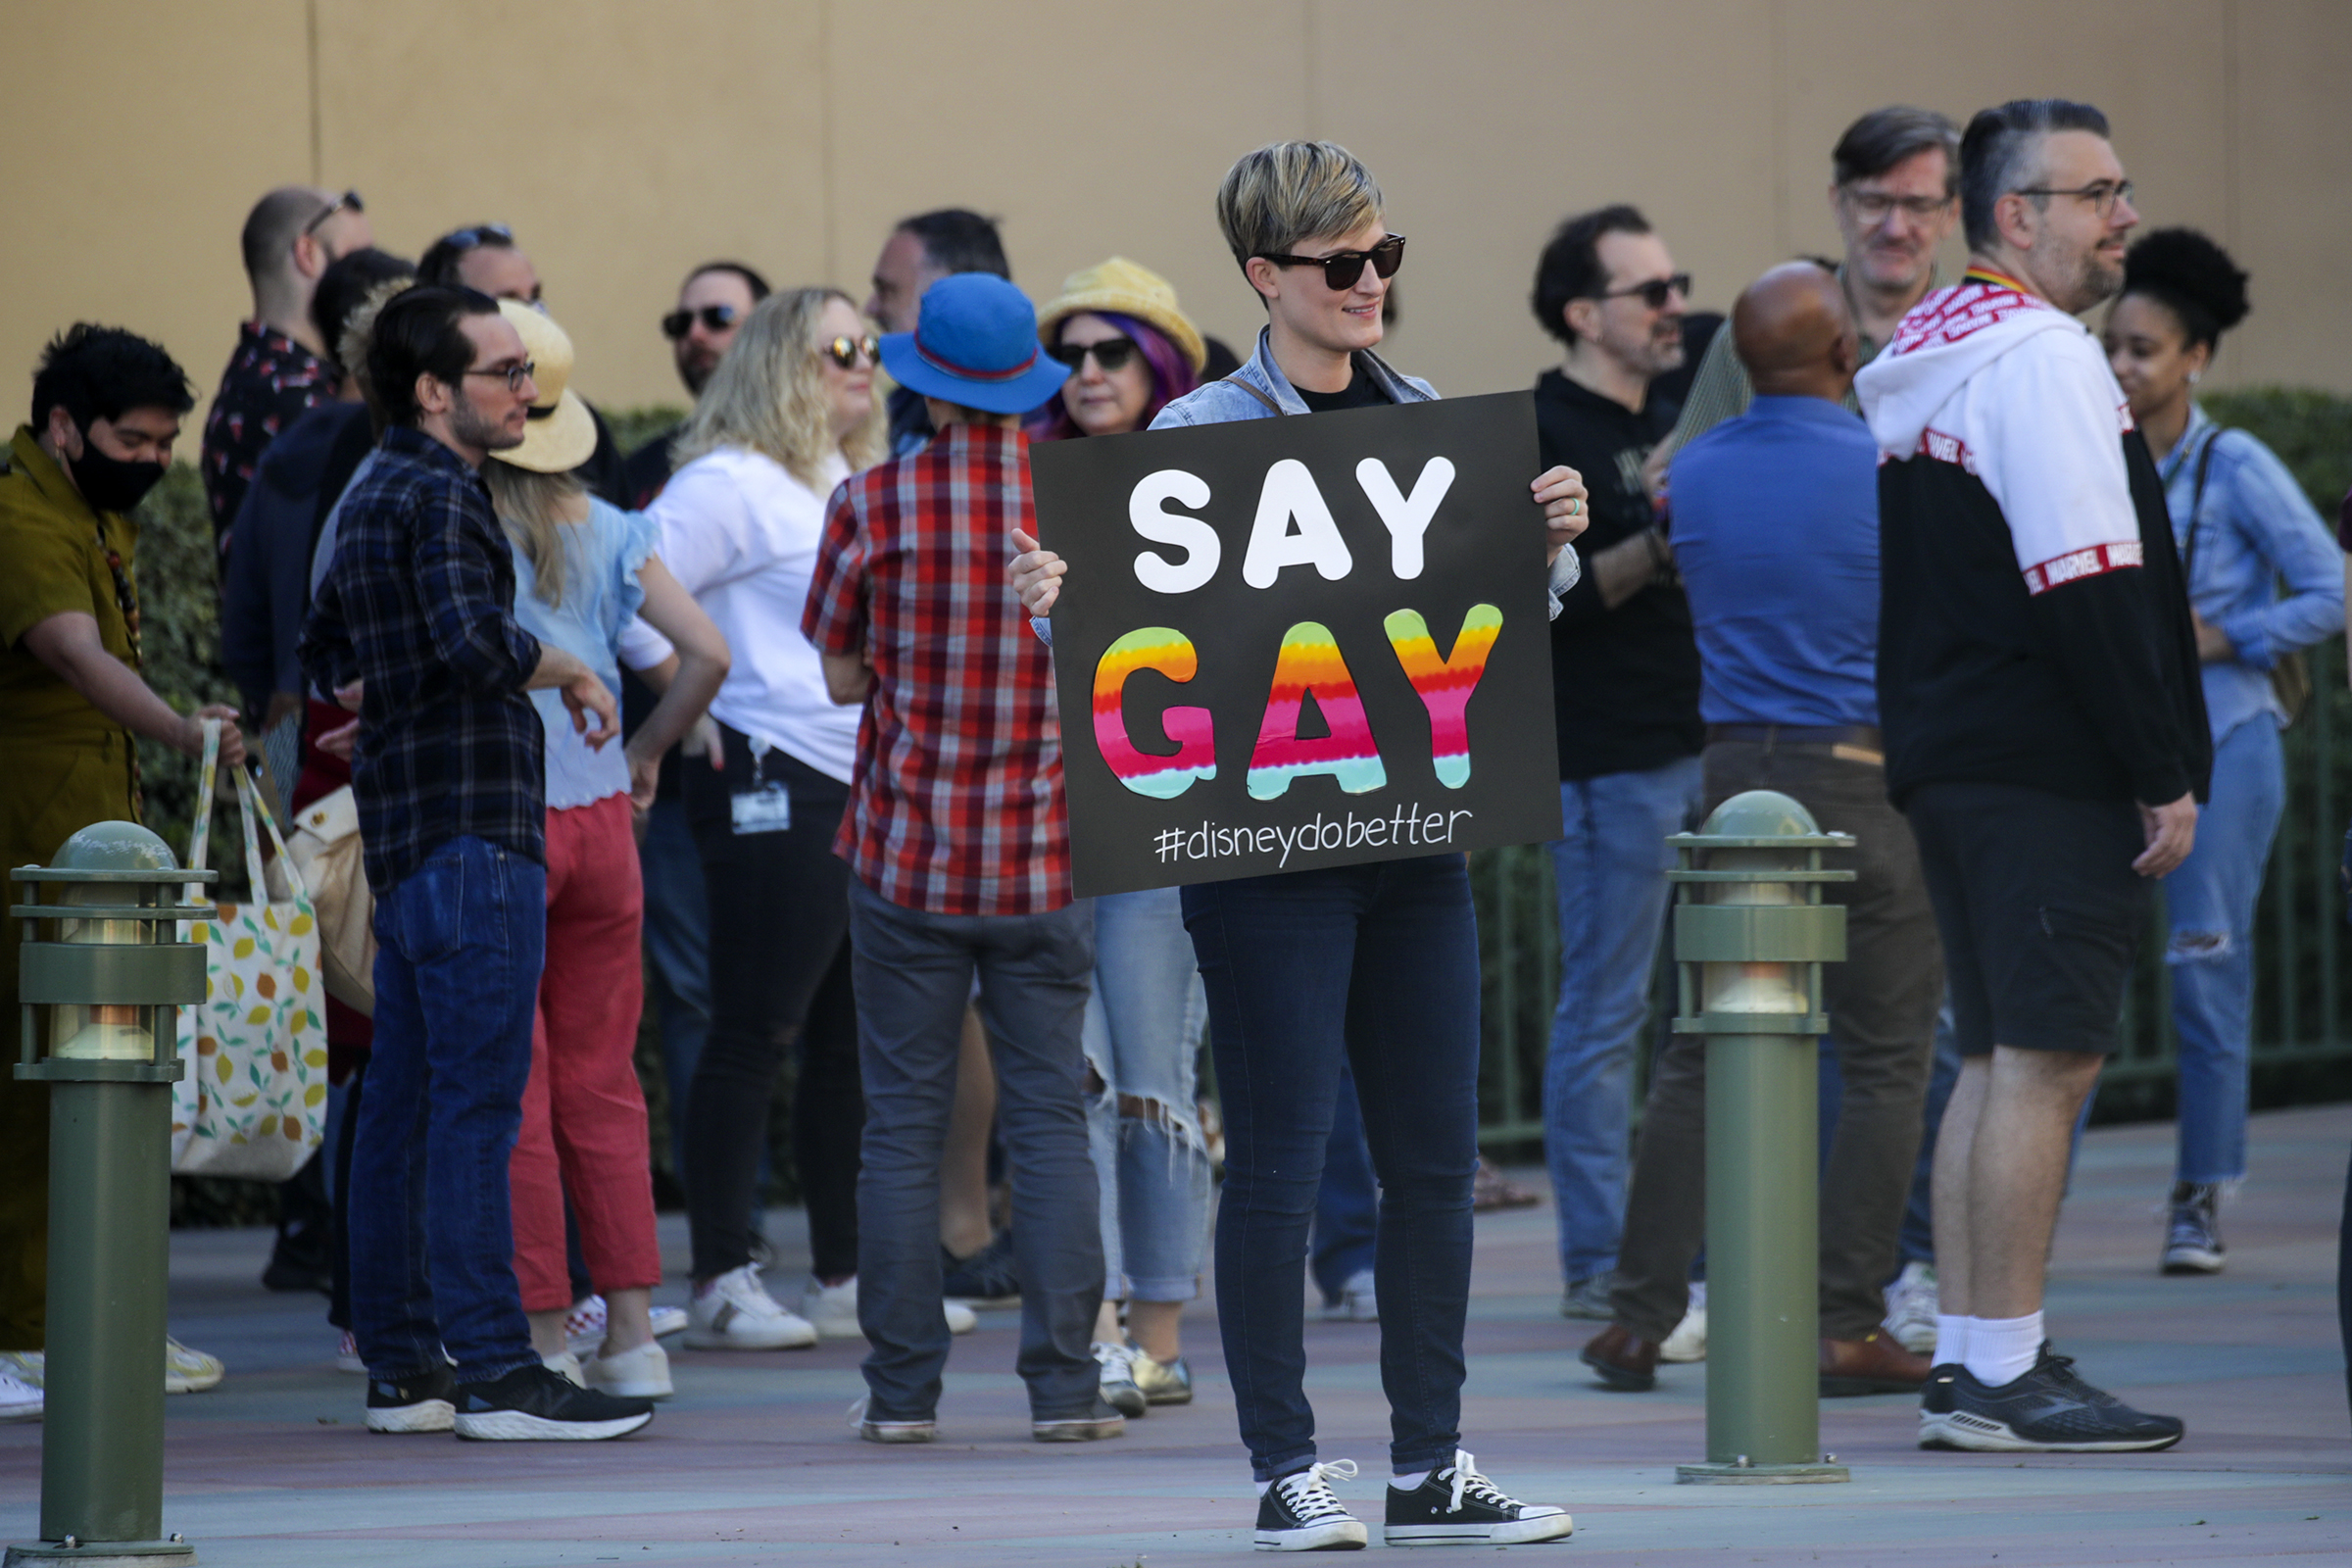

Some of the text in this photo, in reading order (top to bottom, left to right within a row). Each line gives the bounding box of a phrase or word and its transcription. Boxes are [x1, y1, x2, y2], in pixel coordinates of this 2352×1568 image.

[1129, 457, 1456, 594] SAY
[2043, 548, 2103, 586] MARVEL
[1091, 603, 1504, 802] GAY
[1153, 803, 1473, 869] #disneydobetter
